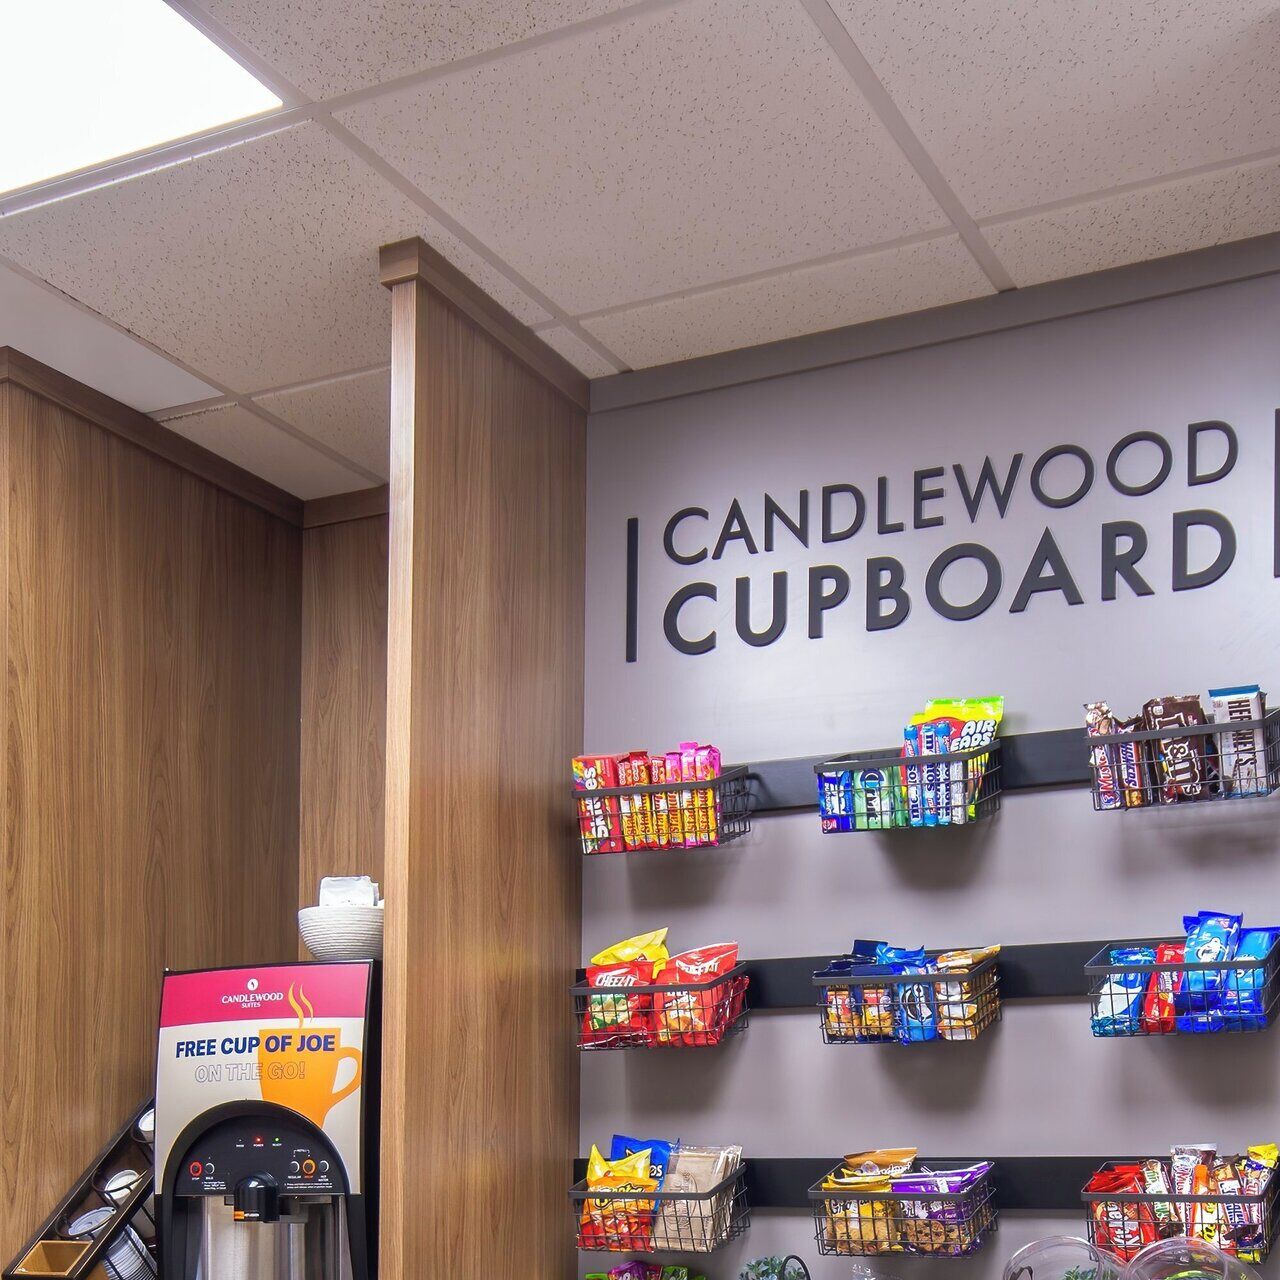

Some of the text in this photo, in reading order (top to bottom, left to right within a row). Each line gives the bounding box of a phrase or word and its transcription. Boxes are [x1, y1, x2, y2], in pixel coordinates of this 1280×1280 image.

[663, 419, 1239, 565] CANDLEWOOD
[663, 509, 1237, 655] CUPBOARD
[962, 720, 996, 737] AIR
[951, 732, 993, 752] EADS
[222, 992, 284, 1004] CANDLEWOOD
[241, 1001, 261, 1009] SUITES
[176, 1034, 336, 1058] FREE CUP OF JOE
[195, 1061, 306, 1083] ON THE GO!
